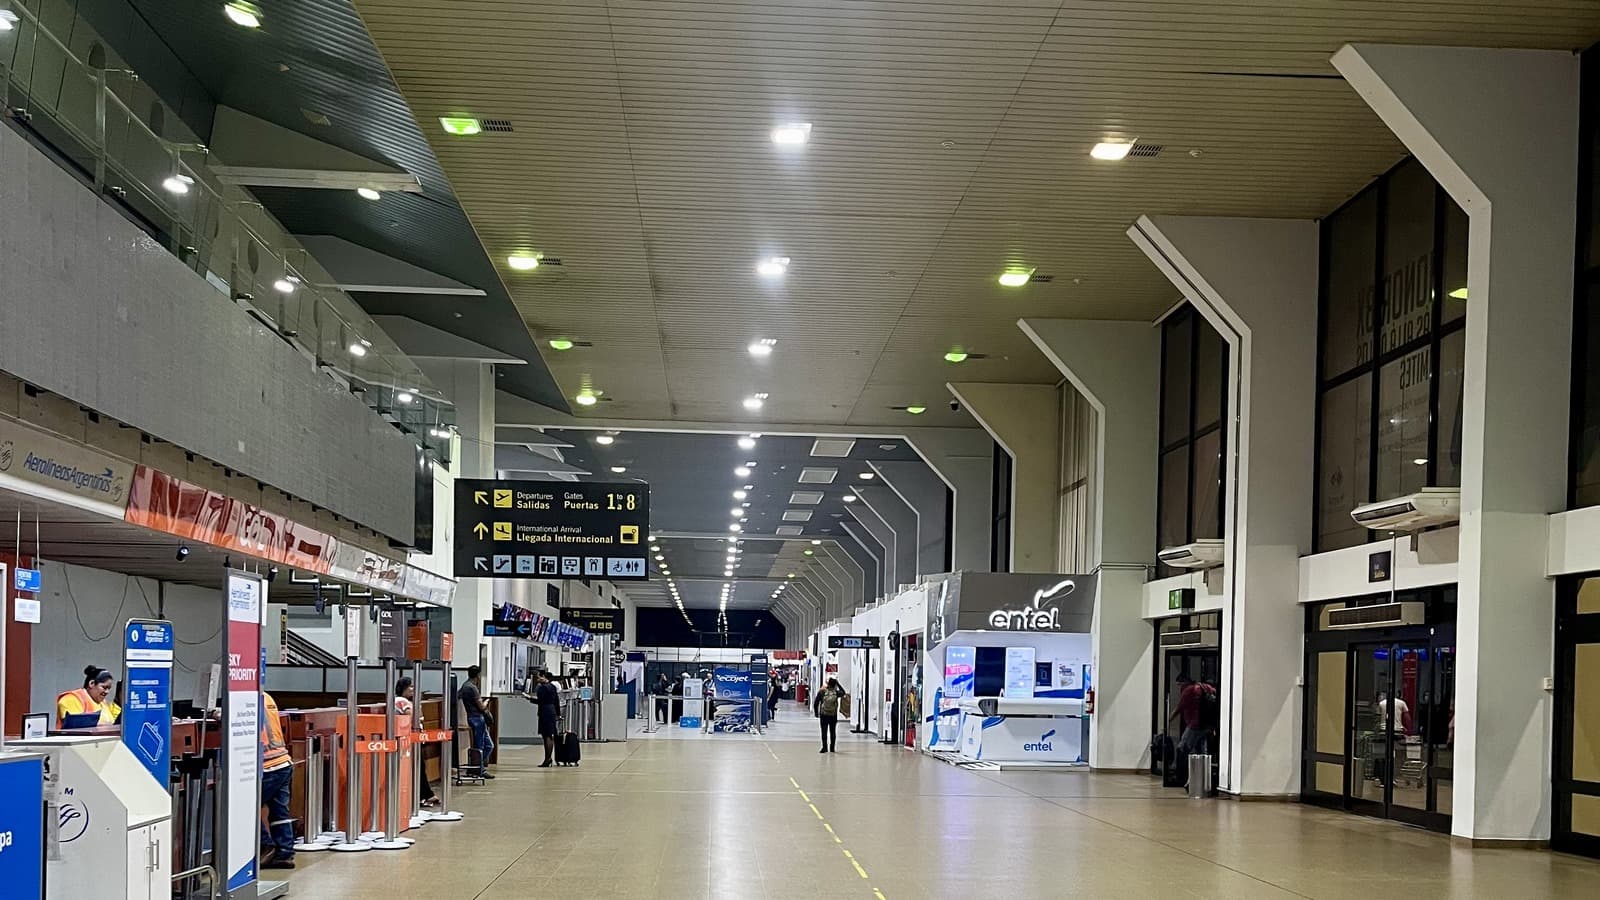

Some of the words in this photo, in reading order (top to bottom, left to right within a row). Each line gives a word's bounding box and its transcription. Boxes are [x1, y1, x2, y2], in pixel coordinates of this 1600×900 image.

[516, 491, 554, 501] Departures
[563, 491, 584, 500] Gates
[516, 500, 550, 510] Salidas
[563, 500, 599, 510] Puertas
[607, 493, 616, 510] 1
[616, 503, 623, 511] a
[626, 494, 635, 511] 8
[516, 524, 559, 533] International
[516, 533, 552, 544] Llegada
[554, 534, 613, 544] Internacional
[380, 611, 393, 619] GOL
[989, 606, 1061, 630] entel
[229, 653, 241, 667] SKY
[229, 668, 257, 681] PRIORITY
[719, 674, 749, 684] ecojet
[368, 741, 389, 751] GOL
[1024, 741, 1053, 752] entel
